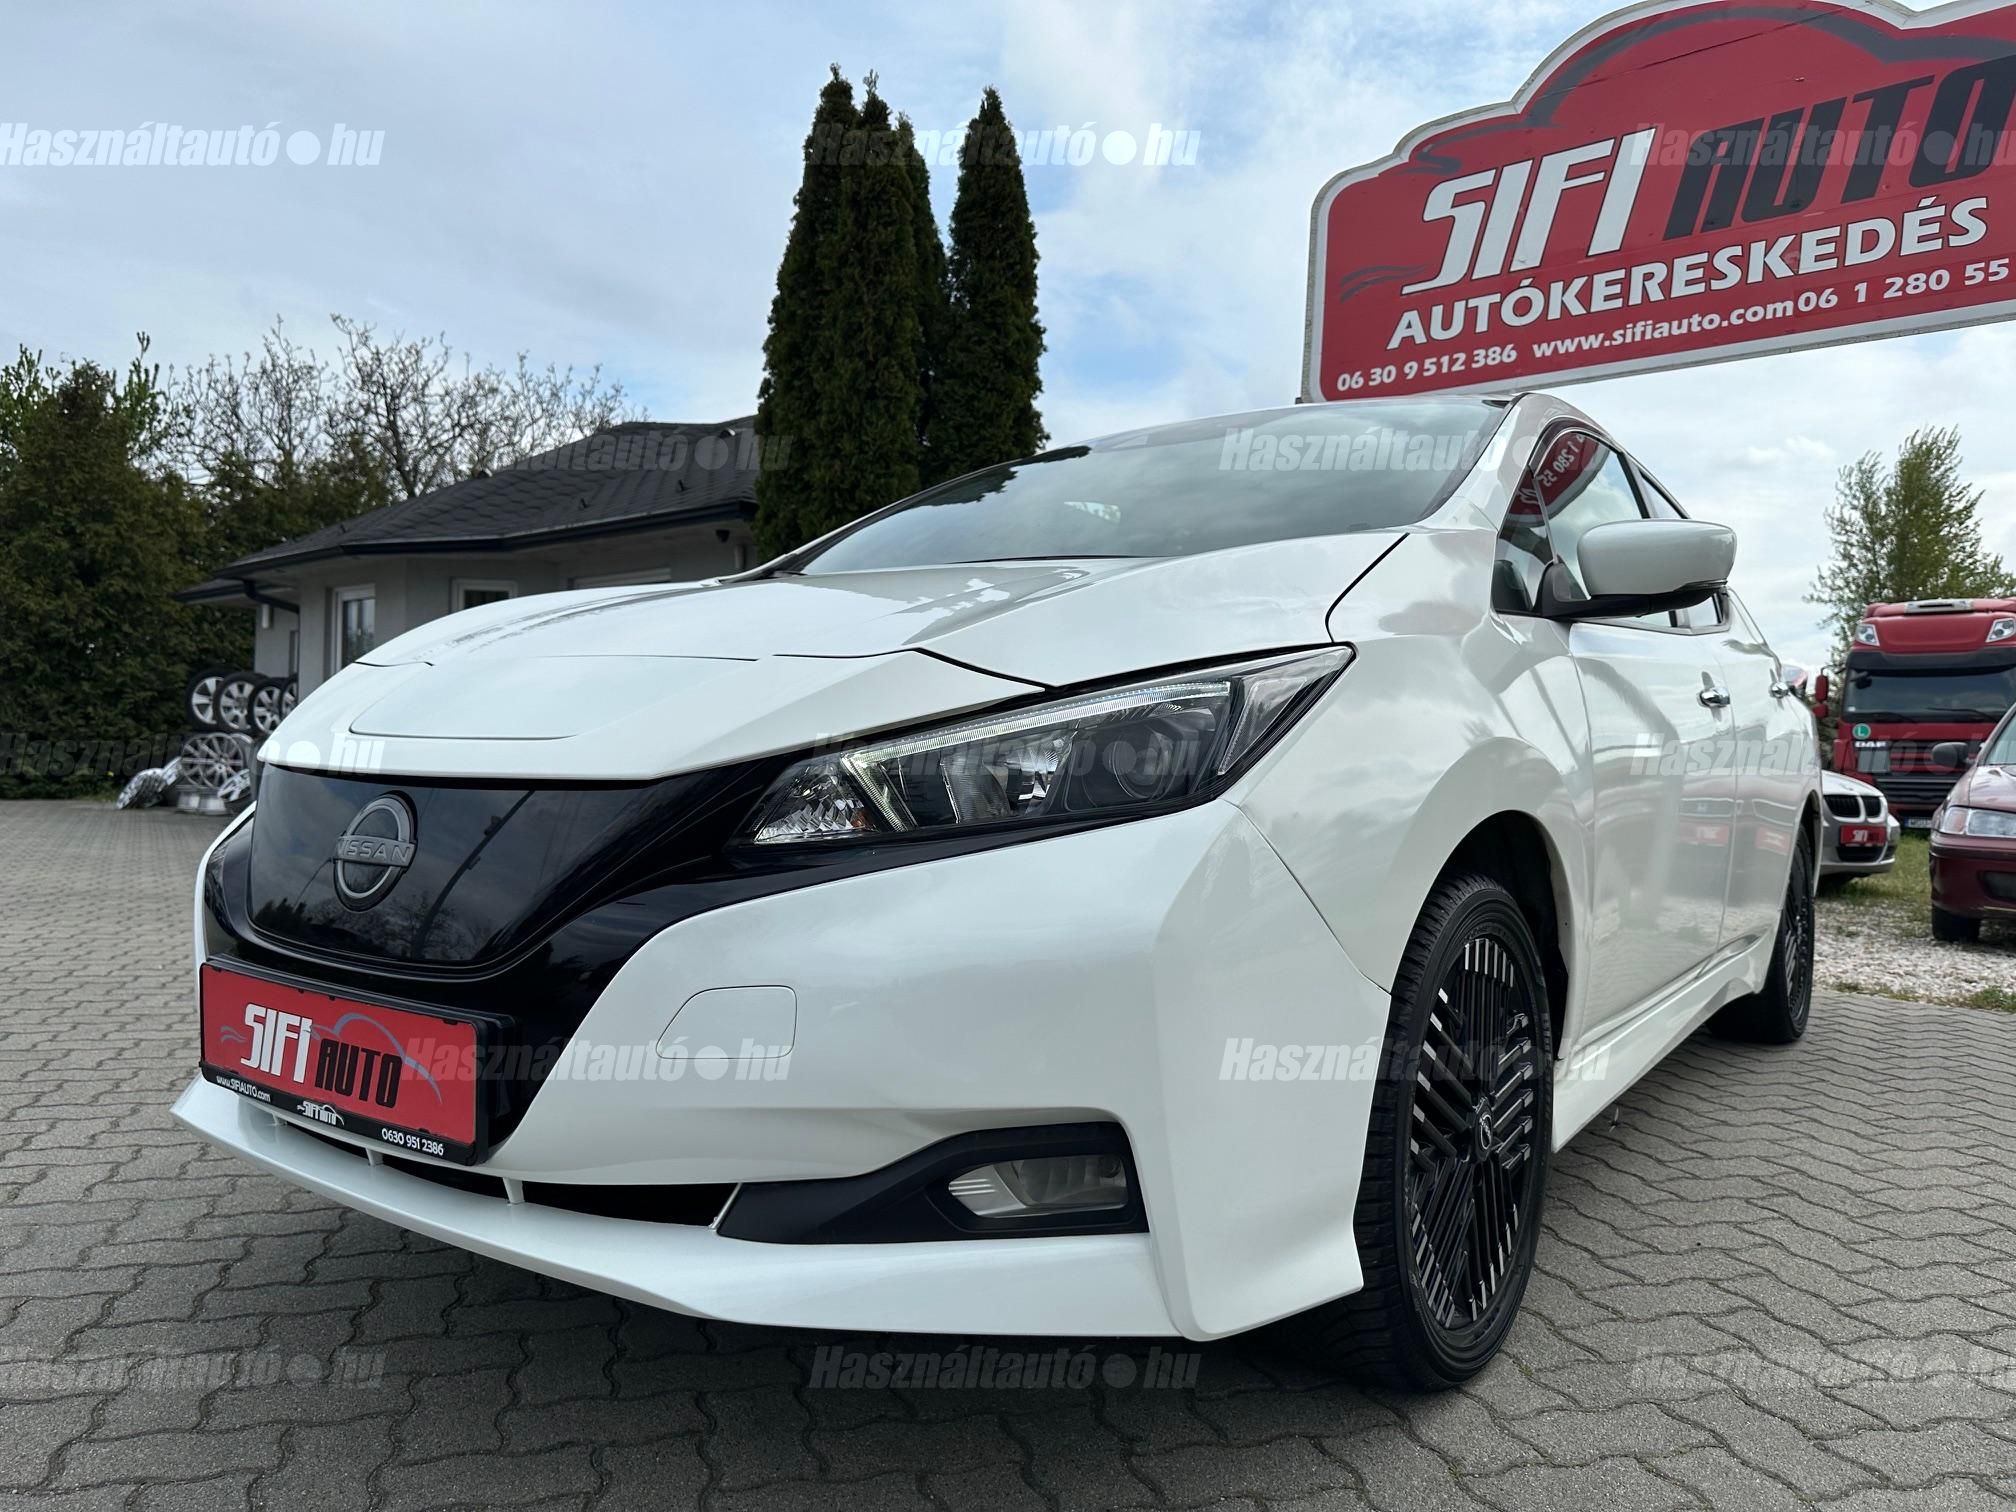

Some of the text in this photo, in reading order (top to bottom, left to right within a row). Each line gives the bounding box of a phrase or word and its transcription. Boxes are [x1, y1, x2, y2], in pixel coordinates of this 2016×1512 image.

[1402, 54, 2016, 295] SIFI AUTO
[1337, 371, 1364, 392] 06
[1368, 365, 1396, 386] 30
[1423, 352, 1465, 377] 512
[1472, 344, 1517, 369] 386
[1532, 299, 1794, 358] www.sifiauto.com
[1797, 288, 1838, 312] 06
[1854, 282, 1868, 303] 1
[1883, 269, 1950, 298] 280
[1964, 258, 2009, 286] 55
[1386, 196, 1988, 350] AUTÓKERESKEDÉS
[337, 839, 410, 863] NISSAN
[240, 1003, 402, 1109] SIFI AUTO
[381, 1127, 444, 1156] 0630 951 2386
